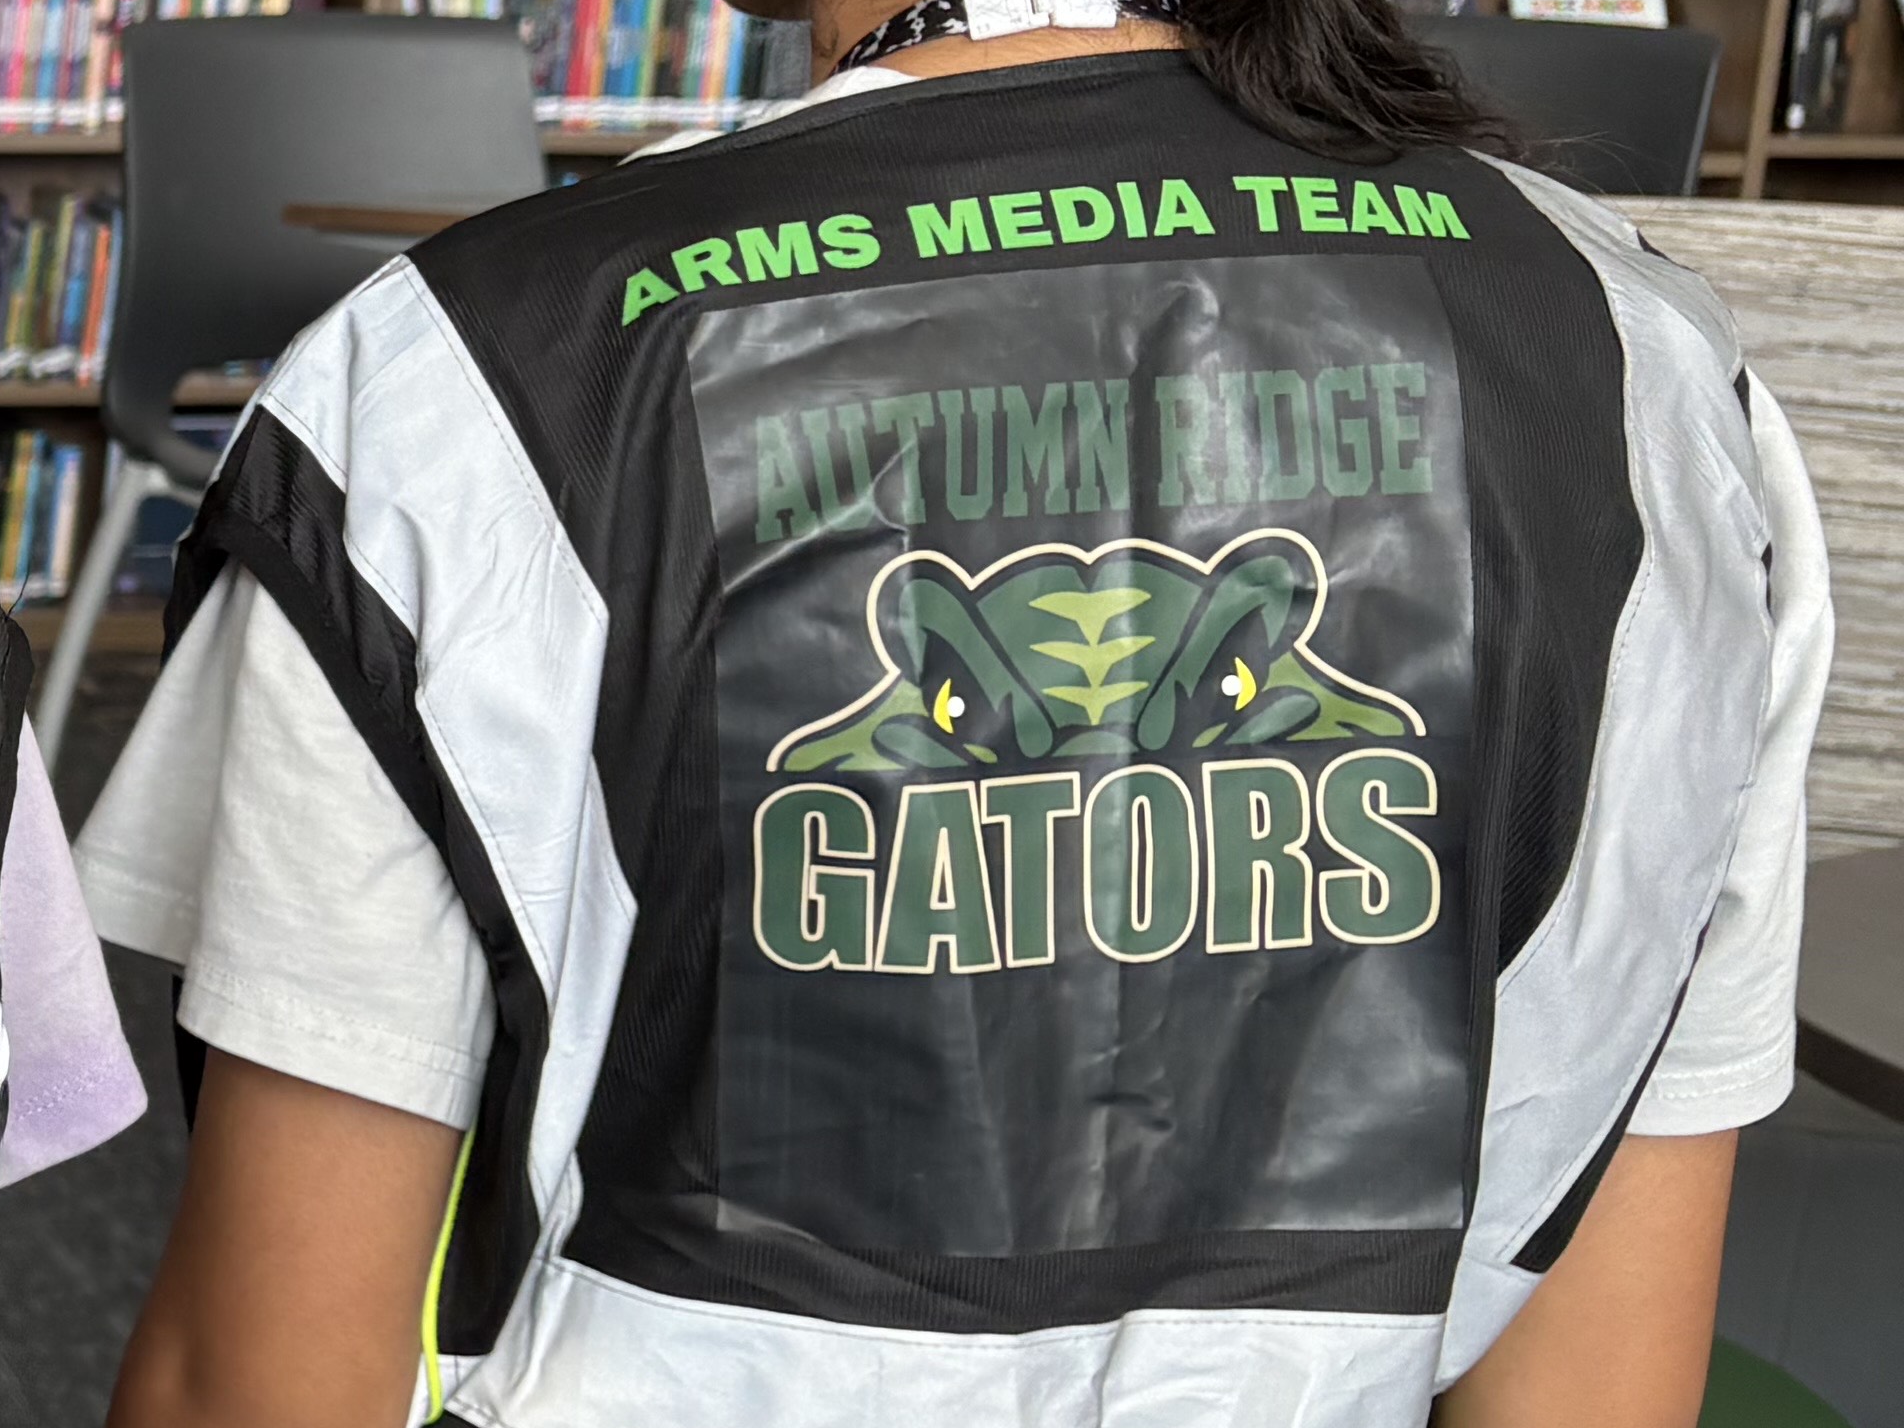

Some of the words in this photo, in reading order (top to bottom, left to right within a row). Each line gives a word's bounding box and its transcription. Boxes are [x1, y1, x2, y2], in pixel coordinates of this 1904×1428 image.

[621, 214, 881, 326] ARMS
[906, 179, 1215, 258] MEDIA
[1233, 176, 1472, 240] TEAM
[754, 377, 1133, 543] AUTUMN
[1156, 362, 1433, 508] RIDGE
[753, 747, 1439, 974] GATORS
